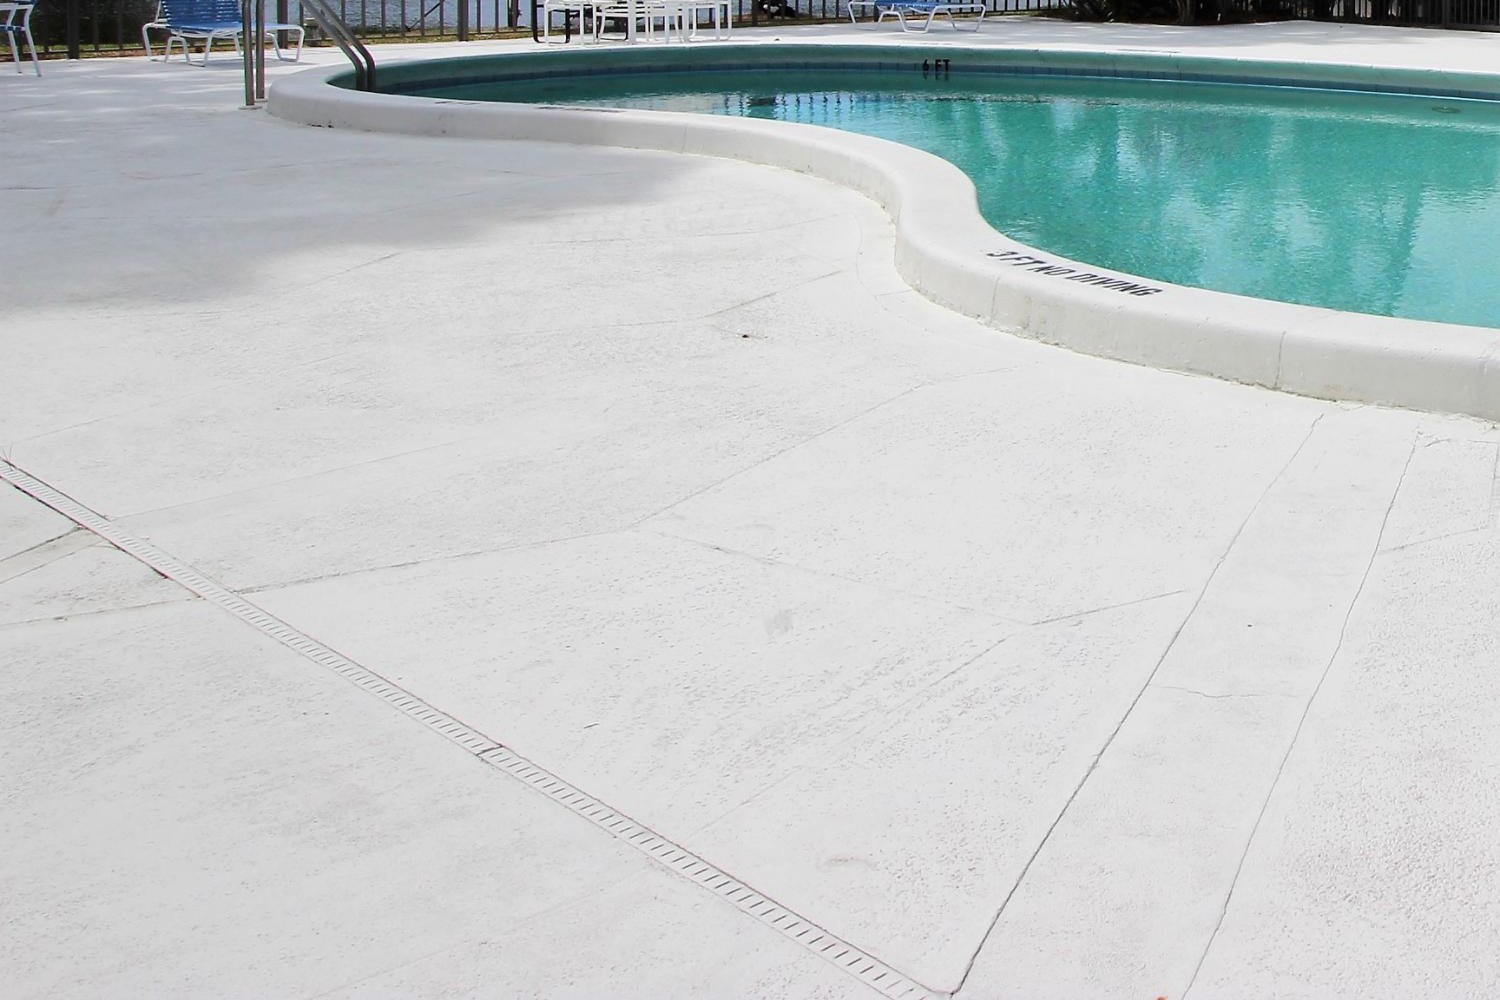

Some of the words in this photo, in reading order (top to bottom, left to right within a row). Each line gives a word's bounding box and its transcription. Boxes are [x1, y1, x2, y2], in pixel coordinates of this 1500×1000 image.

[934, 58, 951, 72] FT
[1026, 265, 1076, 275] NO
[1065, 273, 1164, 297] DIVING
